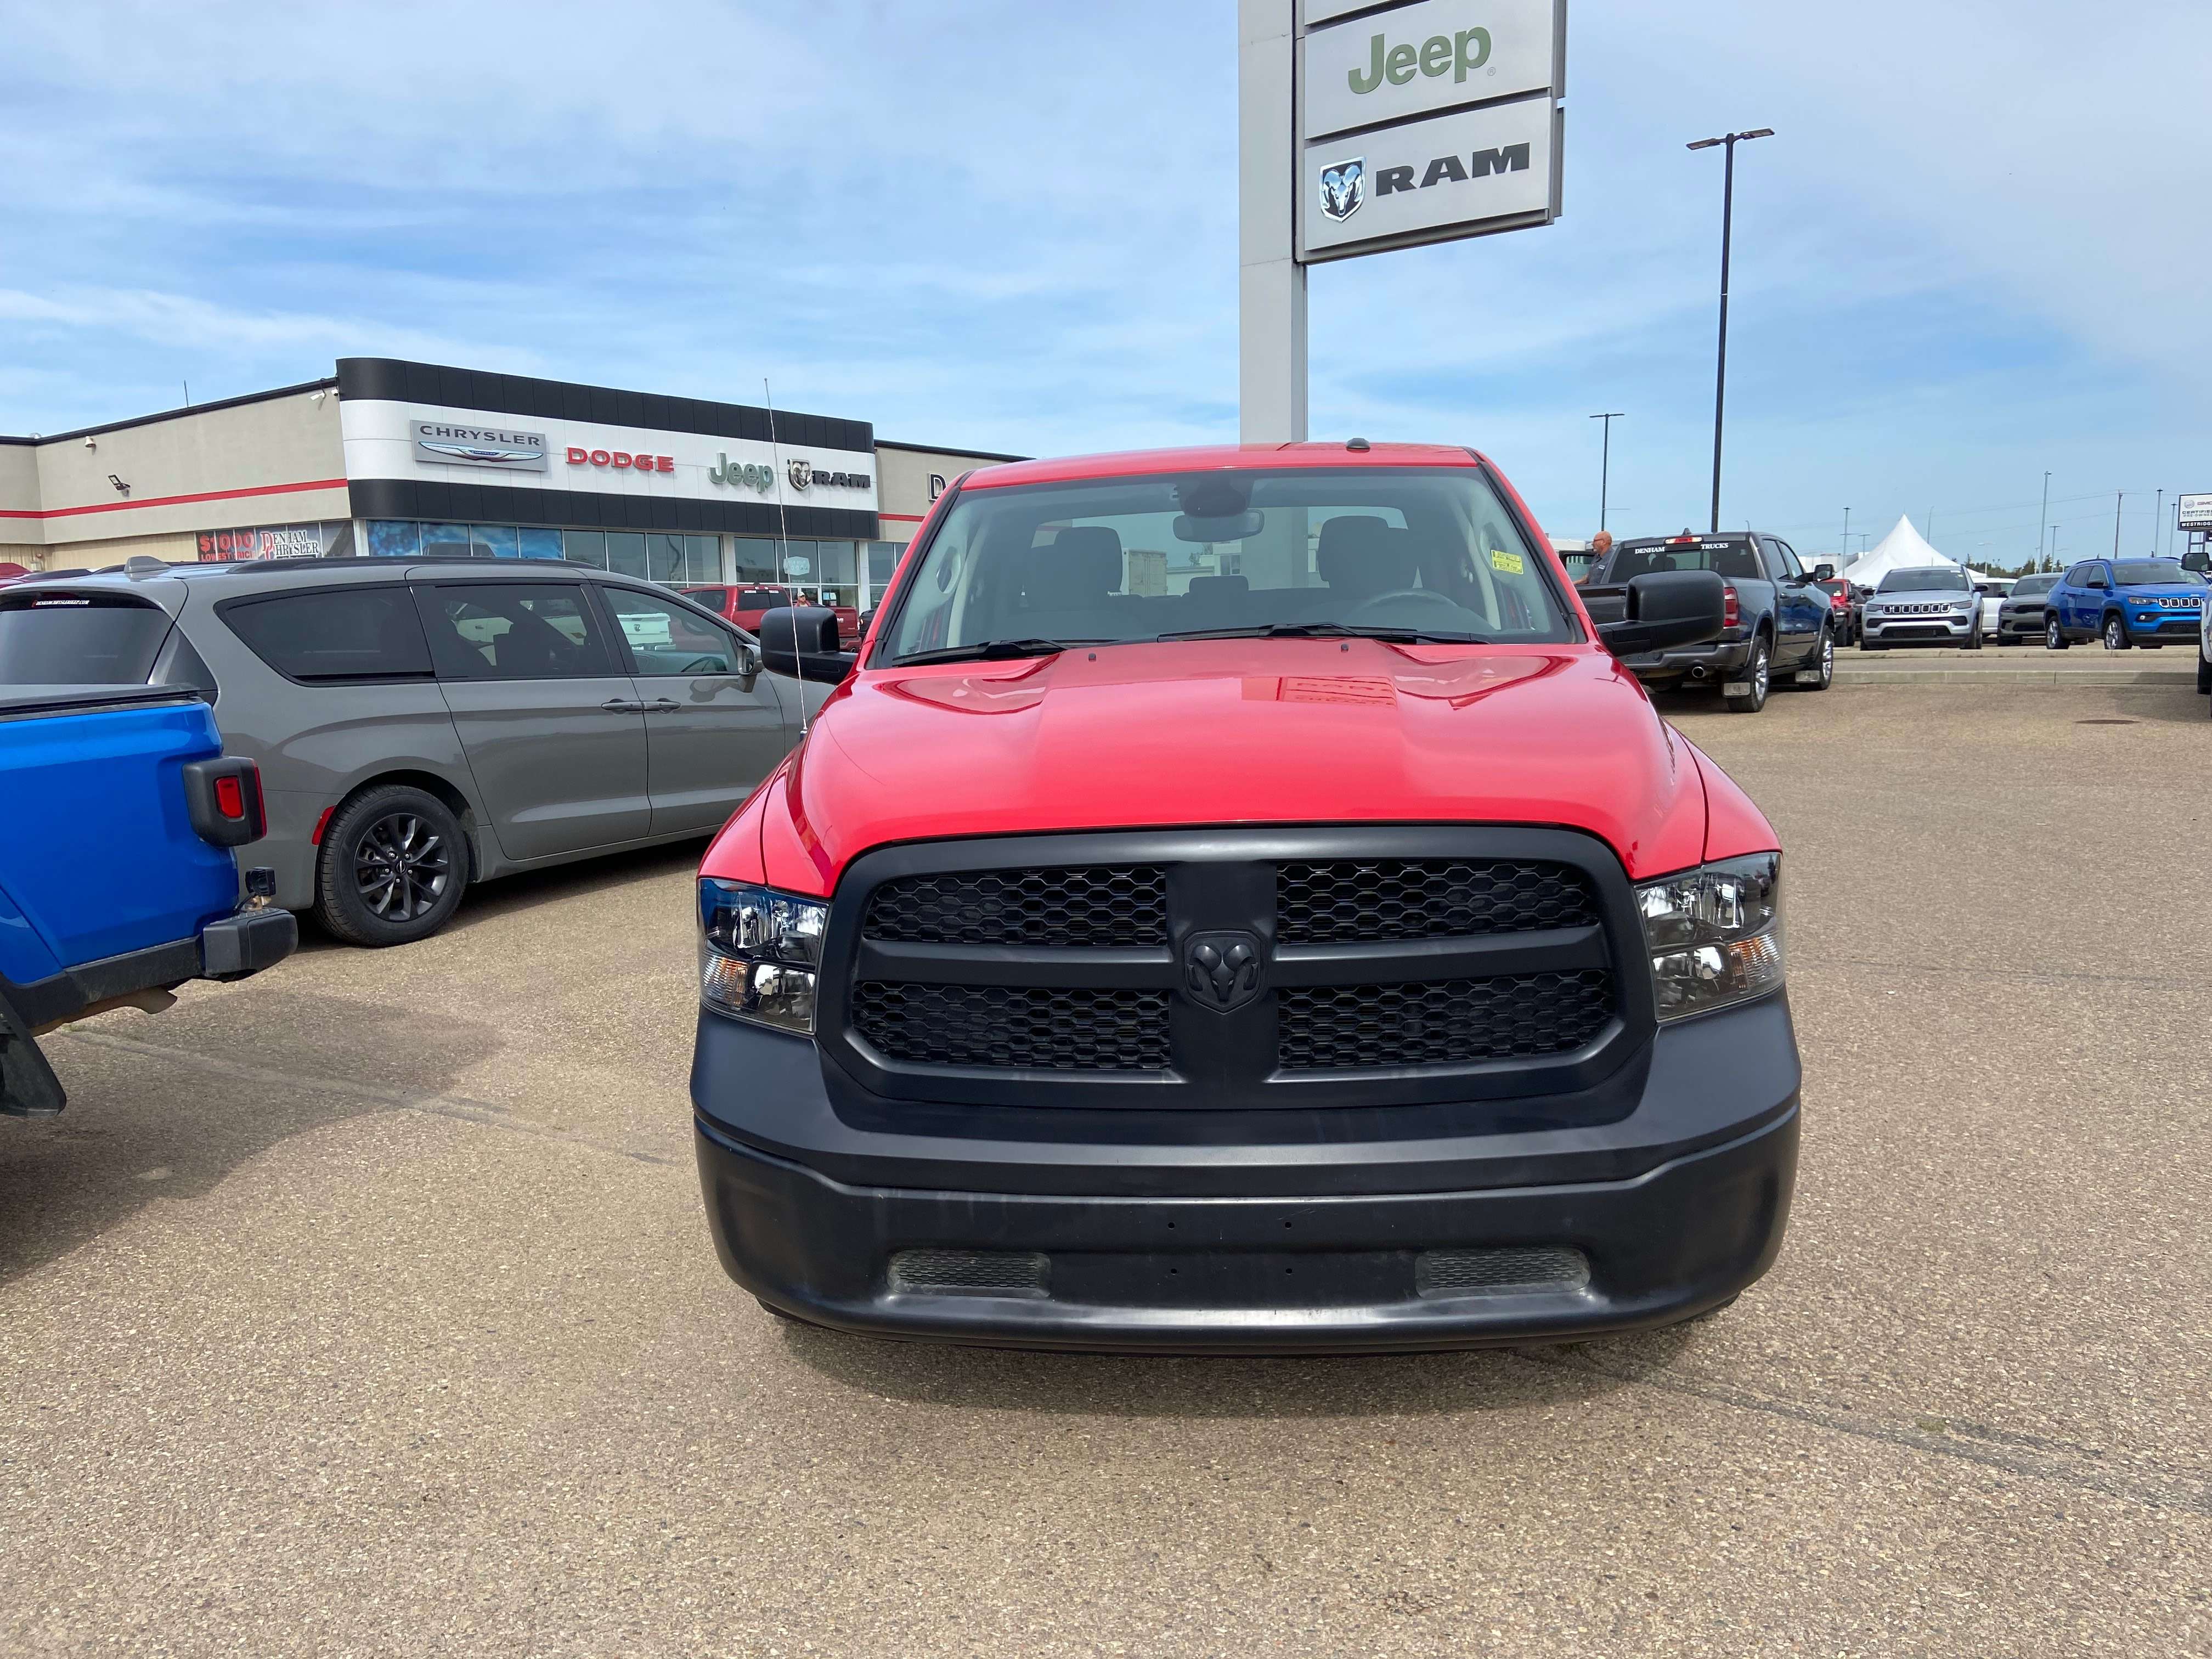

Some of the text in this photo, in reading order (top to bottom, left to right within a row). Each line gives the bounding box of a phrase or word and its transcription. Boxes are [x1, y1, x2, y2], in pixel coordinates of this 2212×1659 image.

[1348, 26, 1491, 94] Jeep
[1376, 142, 1530, 197] RAM
[420, 425, 540, 446] CHRYSLER
[566, 447, 674, 472] DODGE
[707, 453, 774, 493] Jeep
[812, 470, 871, 488] RAM
